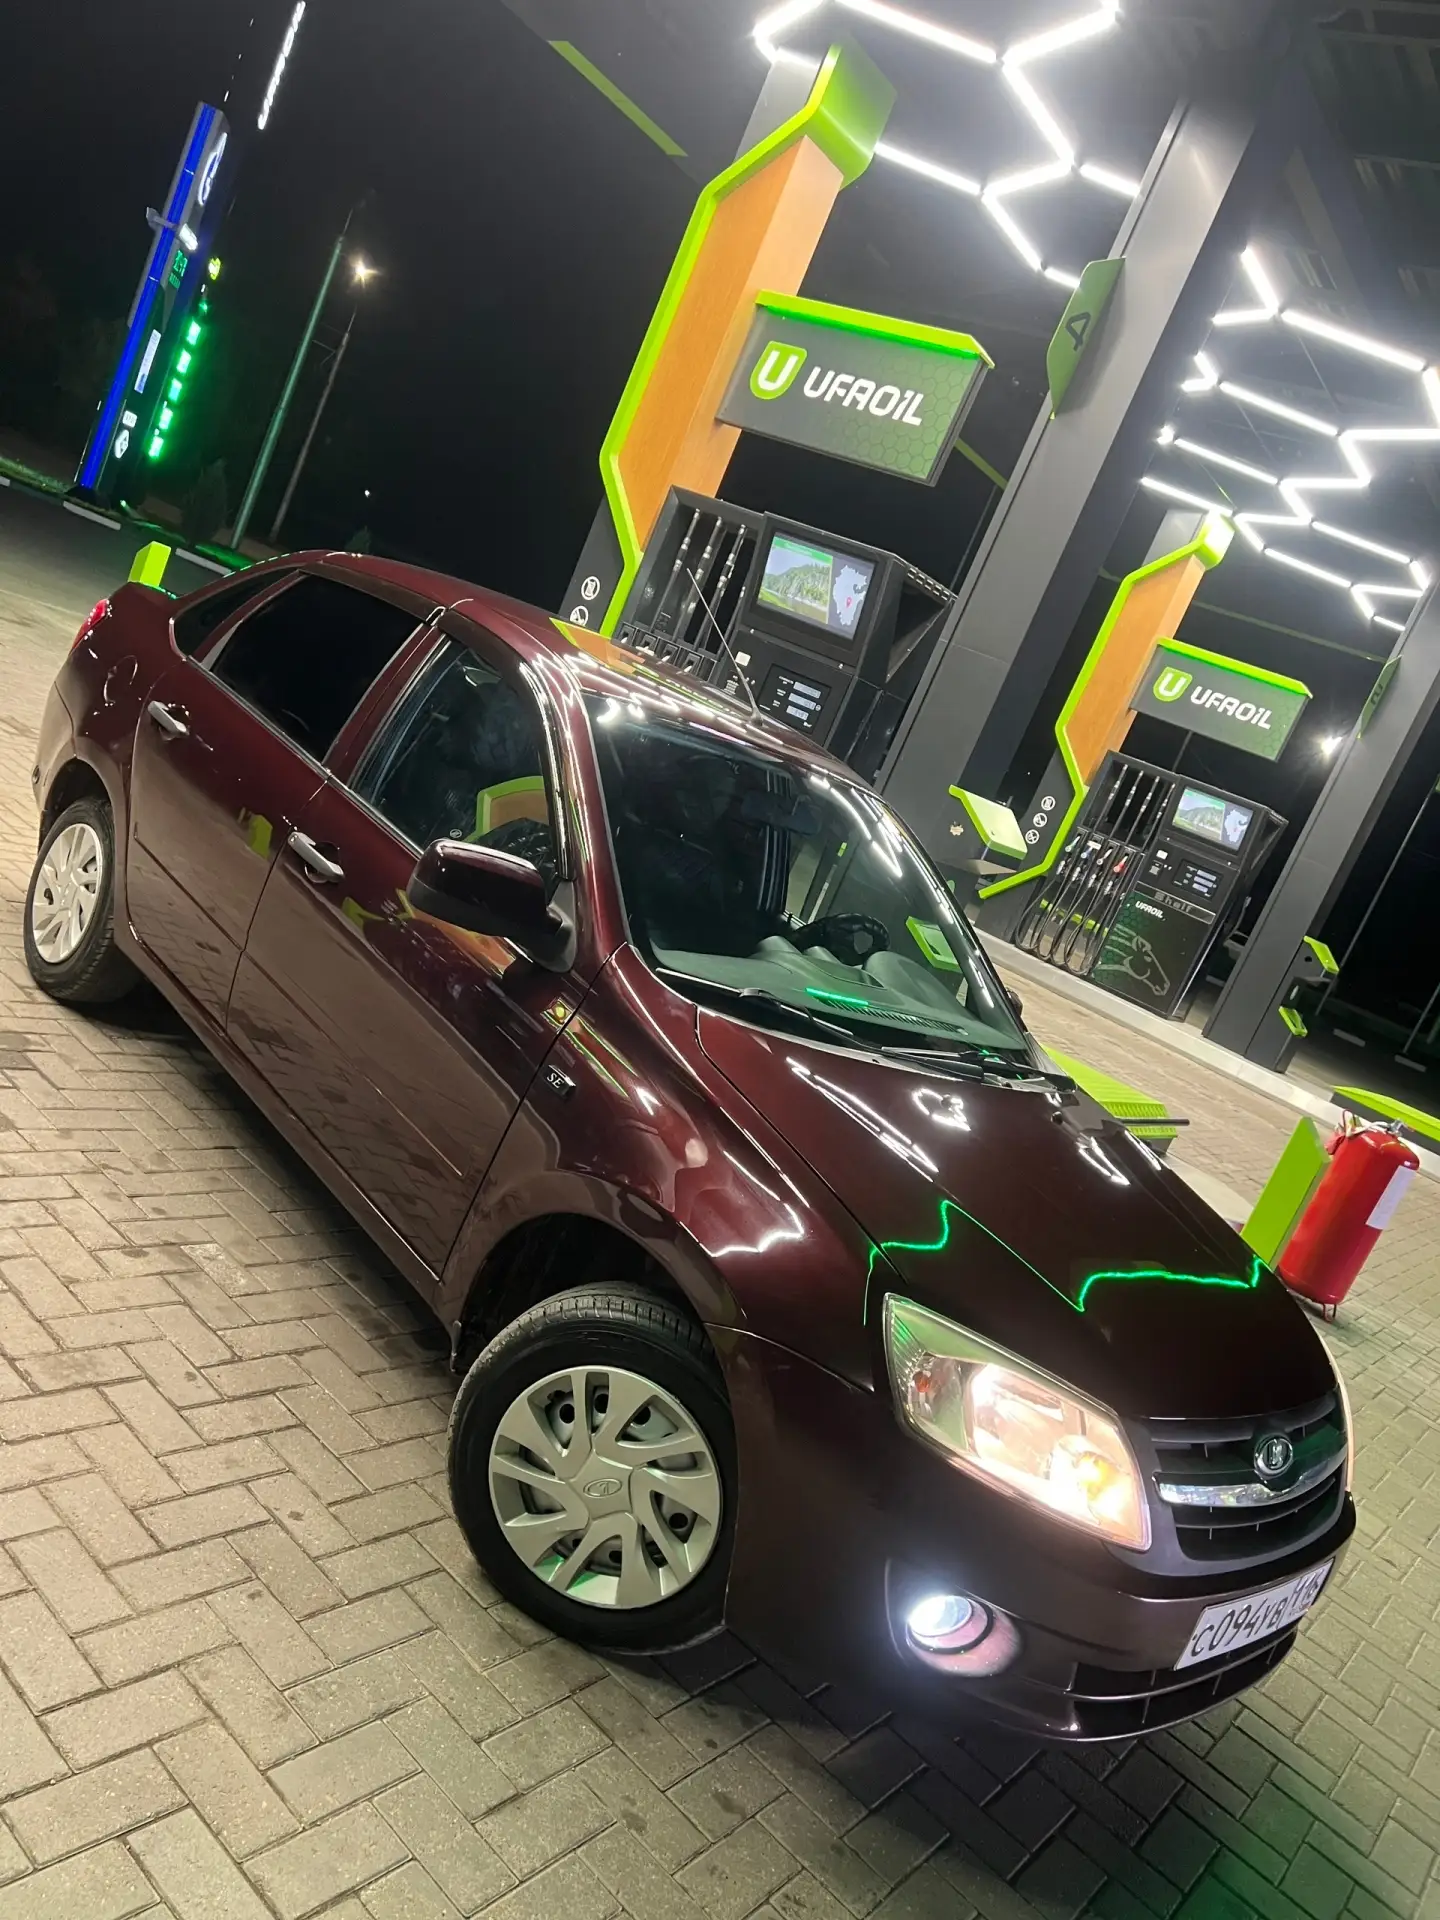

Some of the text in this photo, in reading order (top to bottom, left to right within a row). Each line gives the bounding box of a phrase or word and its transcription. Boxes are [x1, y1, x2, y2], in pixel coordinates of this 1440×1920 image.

[803, 366, 924, 426] UFAOIL
[1190, 685, 1273, 730] UFAOIL
[546, 1072, 565, 1089] SE
